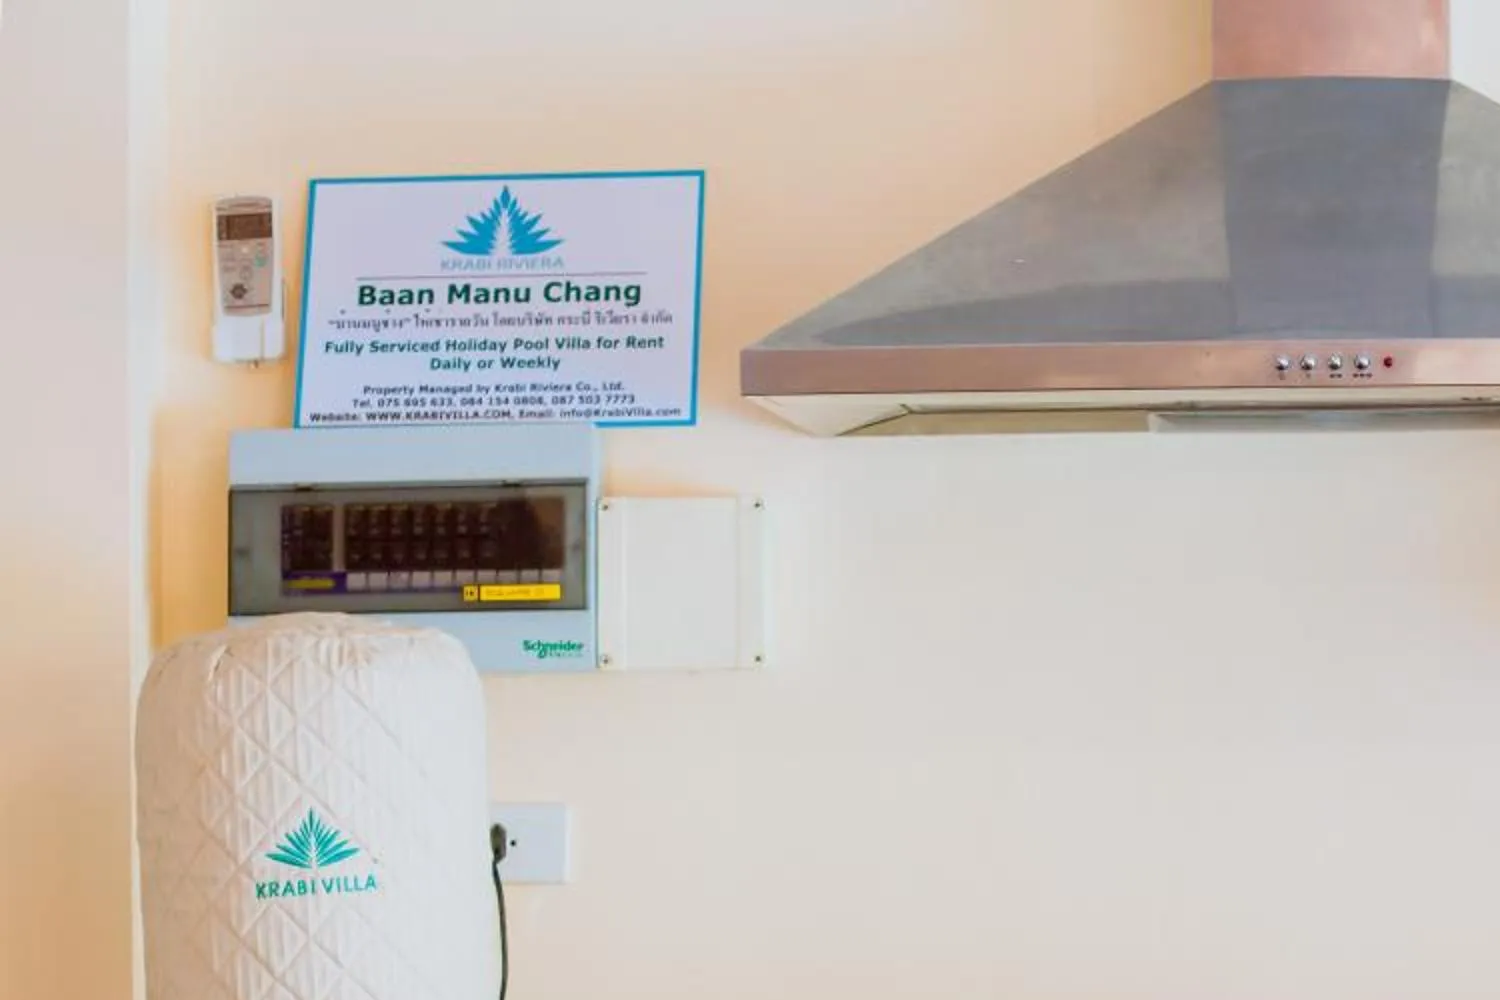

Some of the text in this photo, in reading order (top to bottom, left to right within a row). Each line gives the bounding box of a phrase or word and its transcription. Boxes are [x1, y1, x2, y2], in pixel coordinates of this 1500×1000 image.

[440, 256, 564, 270] KRABI RIVIERA
[358, 280, 641, 307] Baan Manu Chang
[324, 335, 665, 356] Fully Serviced Holiday Pool Villa for Rent
[430, 355, 560, 372] Daily or Weekly
[363, 385, 415, 396] Property
[419, 384, 473, 396] Managed
[476, 383, 490, 395] by
[494, 382, 527, 393] Krabi
[530, 381, 571, 392] Riviera
[602, 381, 625, 391] Ltd.
[377, 398, 400, 407] 075
[310, 412, 360, 423] Website:
[518, 409, 554, 420] Email:
[523, 640, 585, 659] Schneider
[255, 874, 377, 900] KRABI VILLA
